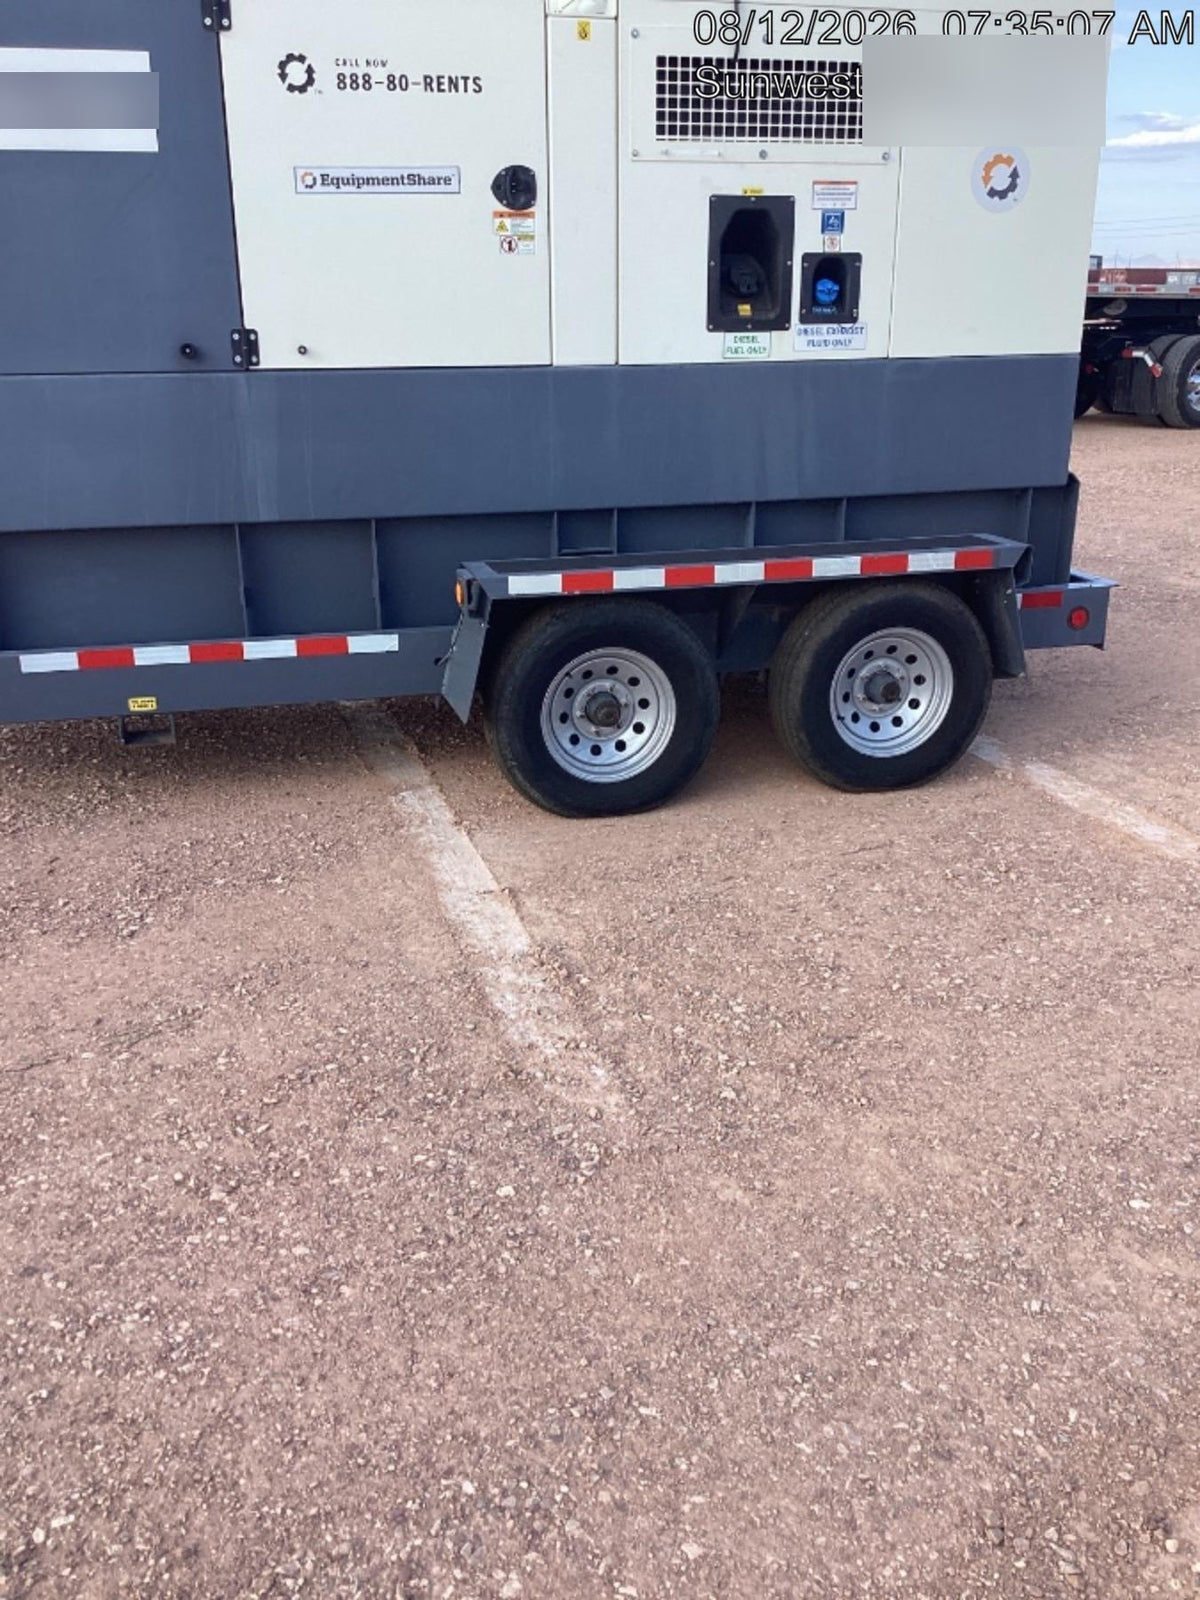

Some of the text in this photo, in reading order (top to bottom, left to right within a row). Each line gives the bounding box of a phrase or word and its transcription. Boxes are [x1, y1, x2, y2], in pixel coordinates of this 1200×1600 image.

[335, 58, 388, 68] CALL NOW
[336, 72, 483, 94] 888-80-RENTS
[320, 172, 453, 189] EquipmentShare
[797, 327, 824, 336] DIESEL
[733, 335, 760, 344] DIESEL
